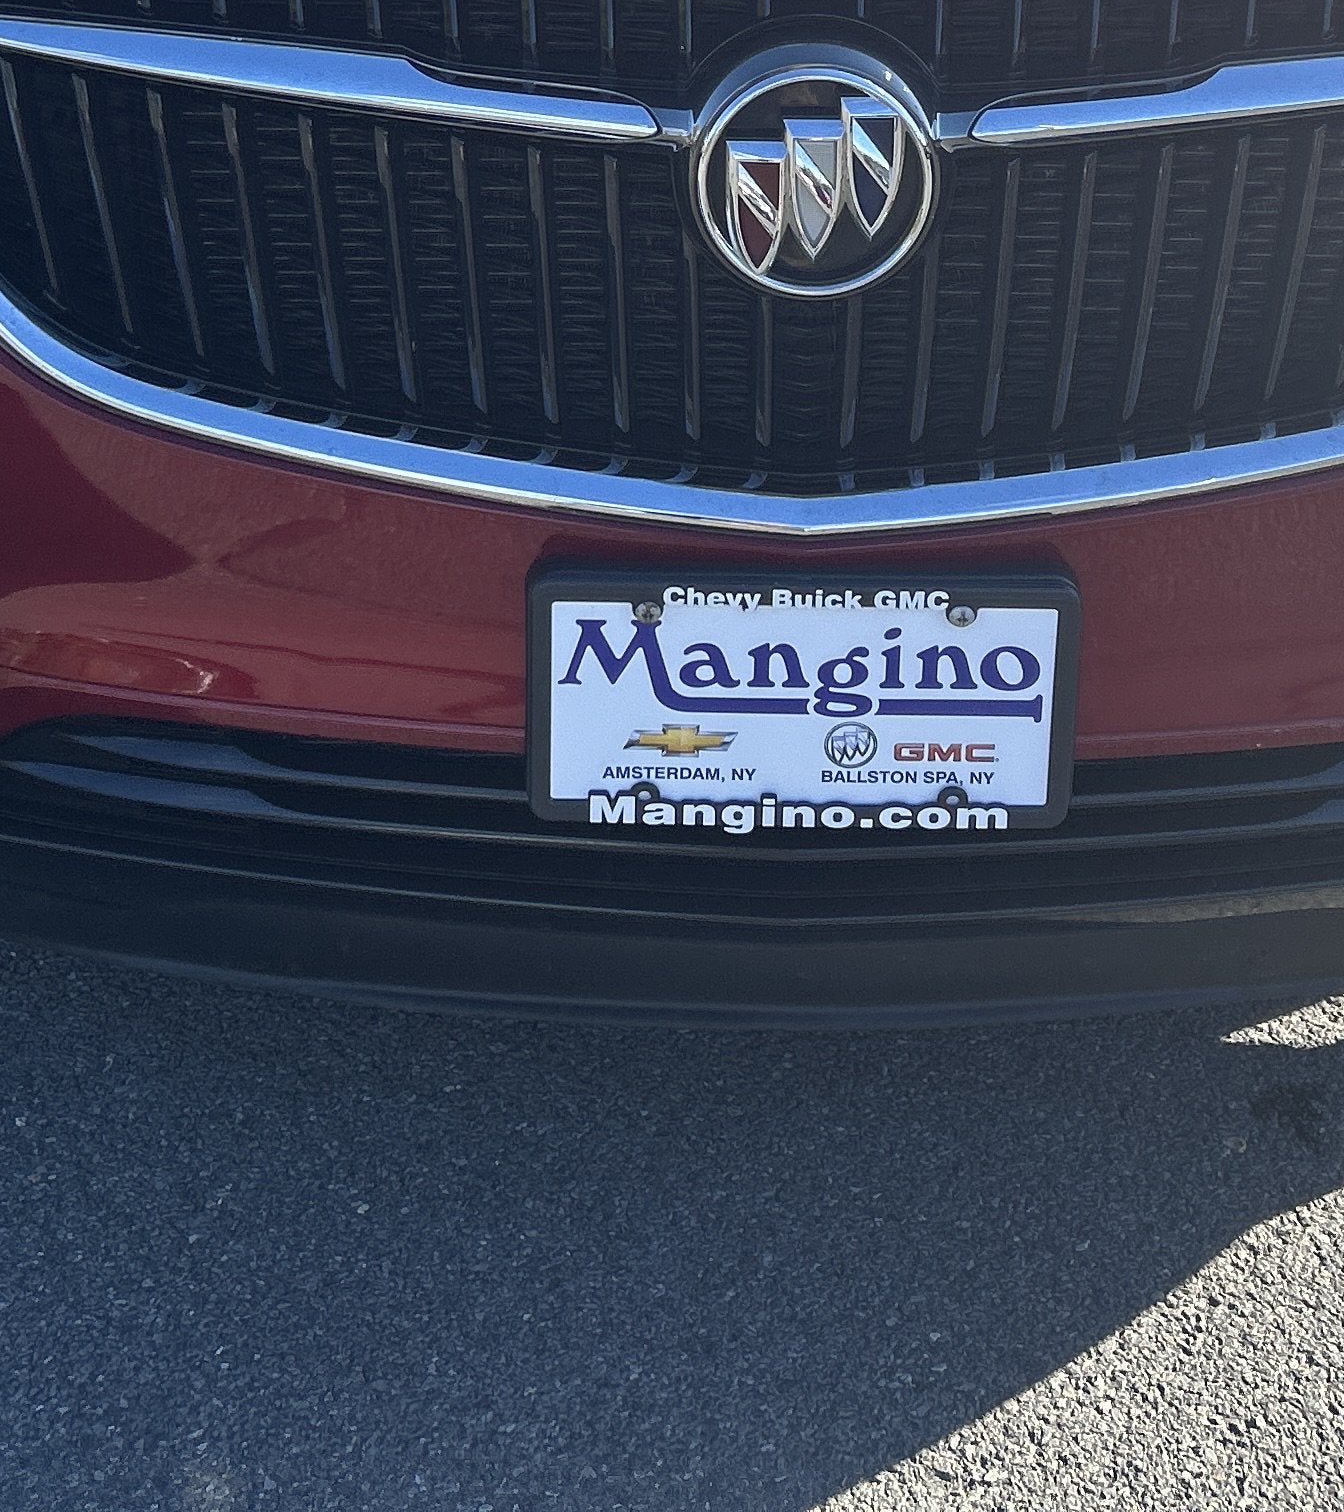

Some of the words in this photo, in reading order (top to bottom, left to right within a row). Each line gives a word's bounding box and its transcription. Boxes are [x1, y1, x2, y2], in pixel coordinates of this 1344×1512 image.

[662, 586, 761, 610] Chevy
[771, 589, 863, 610] Buick
[874, 590, 950, 611] GMC
[558, 618, 1042, 722] Mangino
[893, 743, 996, 763] GMC
[602, 766, 726, 784] AMSTERDAM,
[731, 768, 757, 783] NY
[821, 770, 918, 785] BALLSTON
[922, 771, 963, 786] SPA,
[969, 772, 995, 786] NY
[589, 794, 1009, 834] Mangino.com
